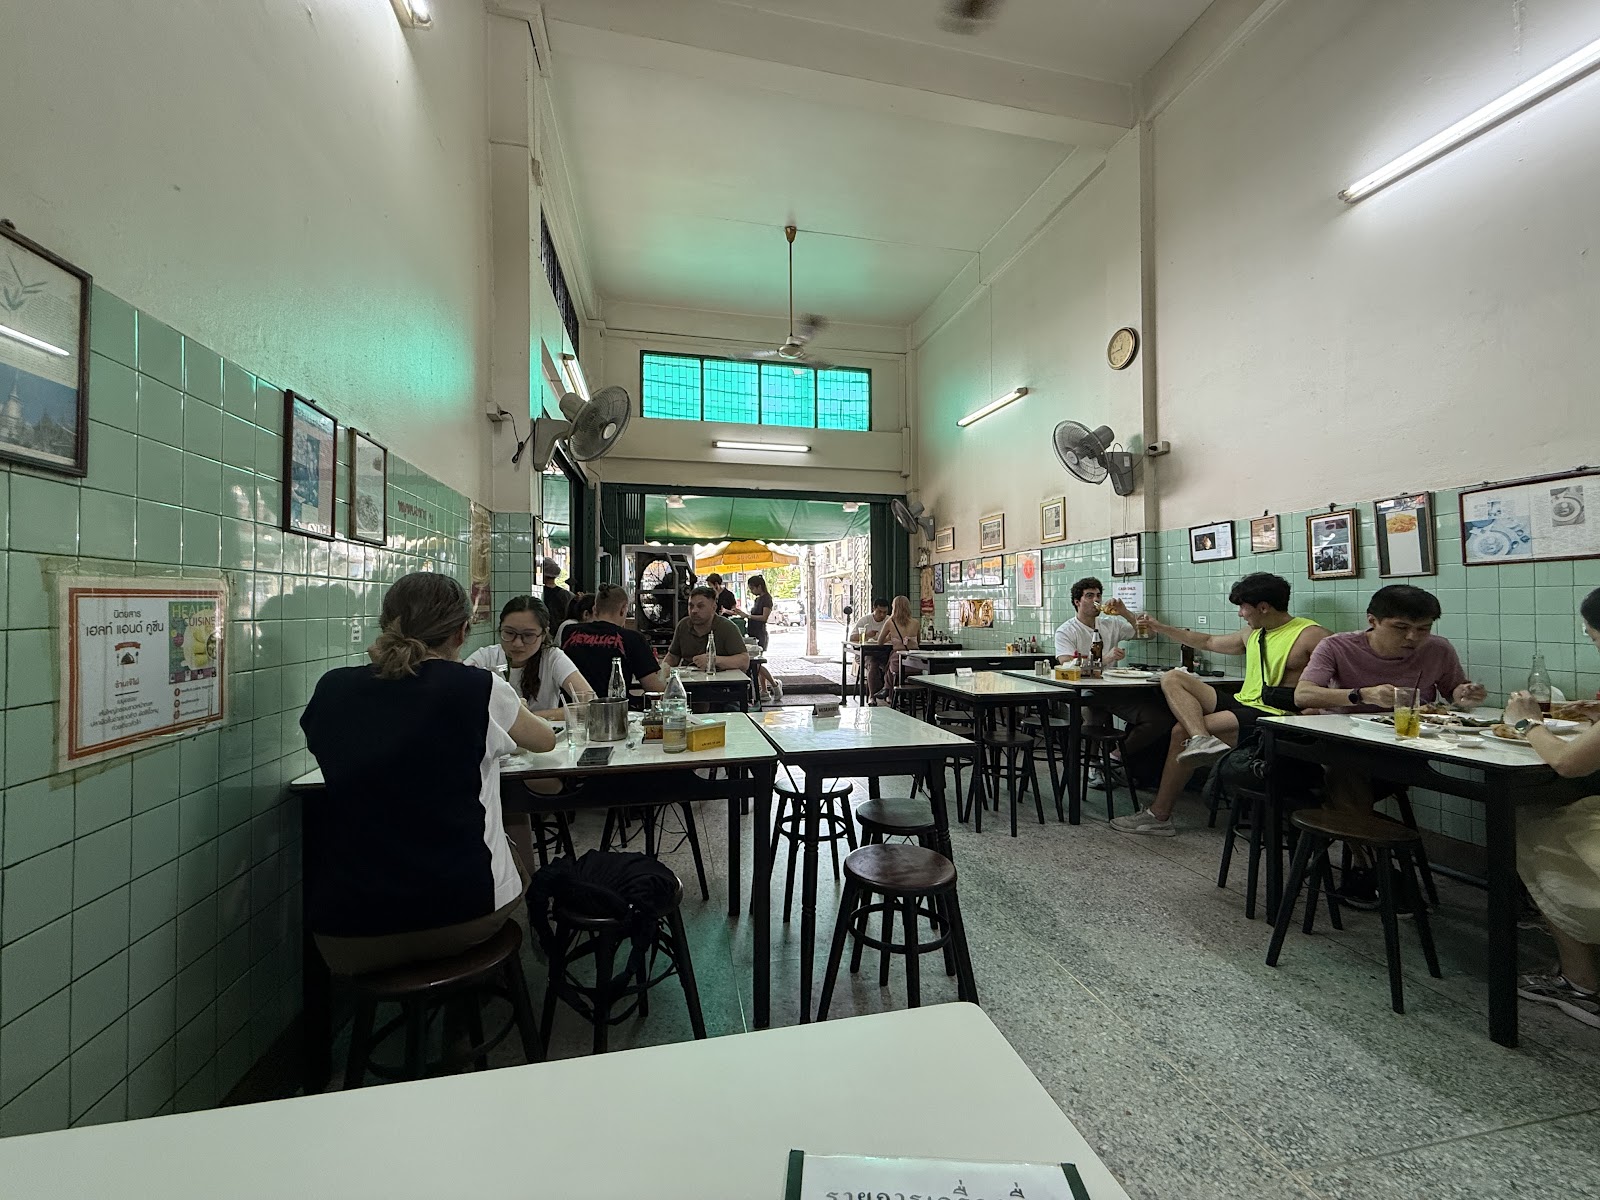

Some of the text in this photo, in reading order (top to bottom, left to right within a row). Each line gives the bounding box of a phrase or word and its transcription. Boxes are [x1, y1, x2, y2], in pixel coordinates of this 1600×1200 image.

[86, 622, 113, 636] เฮลท์
[116, 620, 142, 634] แอนด์
[562, 630, 626, 656] METALLICA
